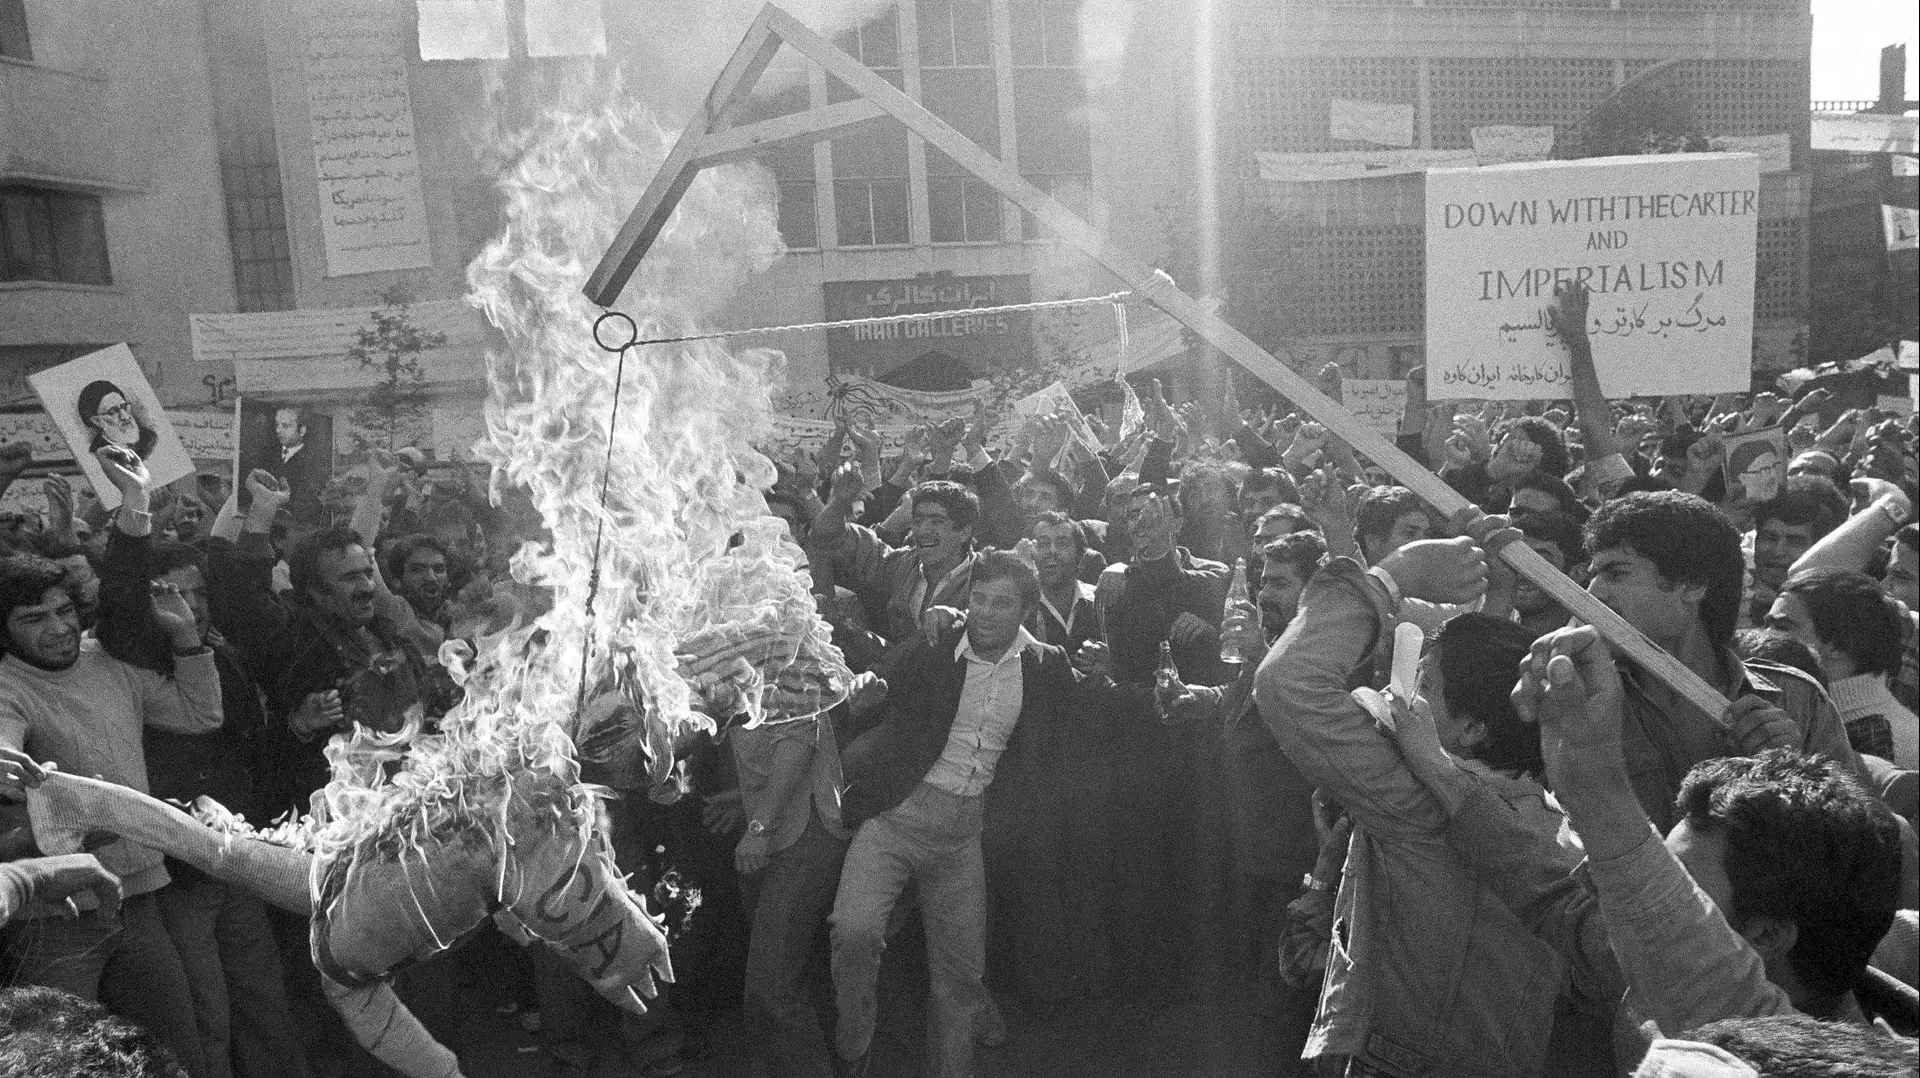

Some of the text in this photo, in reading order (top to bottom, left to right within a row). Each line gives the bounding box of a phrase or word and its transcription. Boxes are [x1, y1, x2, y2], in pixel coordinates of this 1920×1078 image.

[1444, 200, 1538, 229] DOWN
[1586, 230, 1628, 250] AND
[1478, 259, 1725, 301] IMPERIALISM
[1586, 317, 1601, 335] و
[1600, 300, 1649, 338] کارتر
[1675, 291, 1726, 334] مرگ
[853, 314, 1009, 342] IRAN GALLERIES
[1646, 316, 1673, 339] بر
[1465, 363, 1501, 390] ایران
[536, 863, 624, 980] CIA
